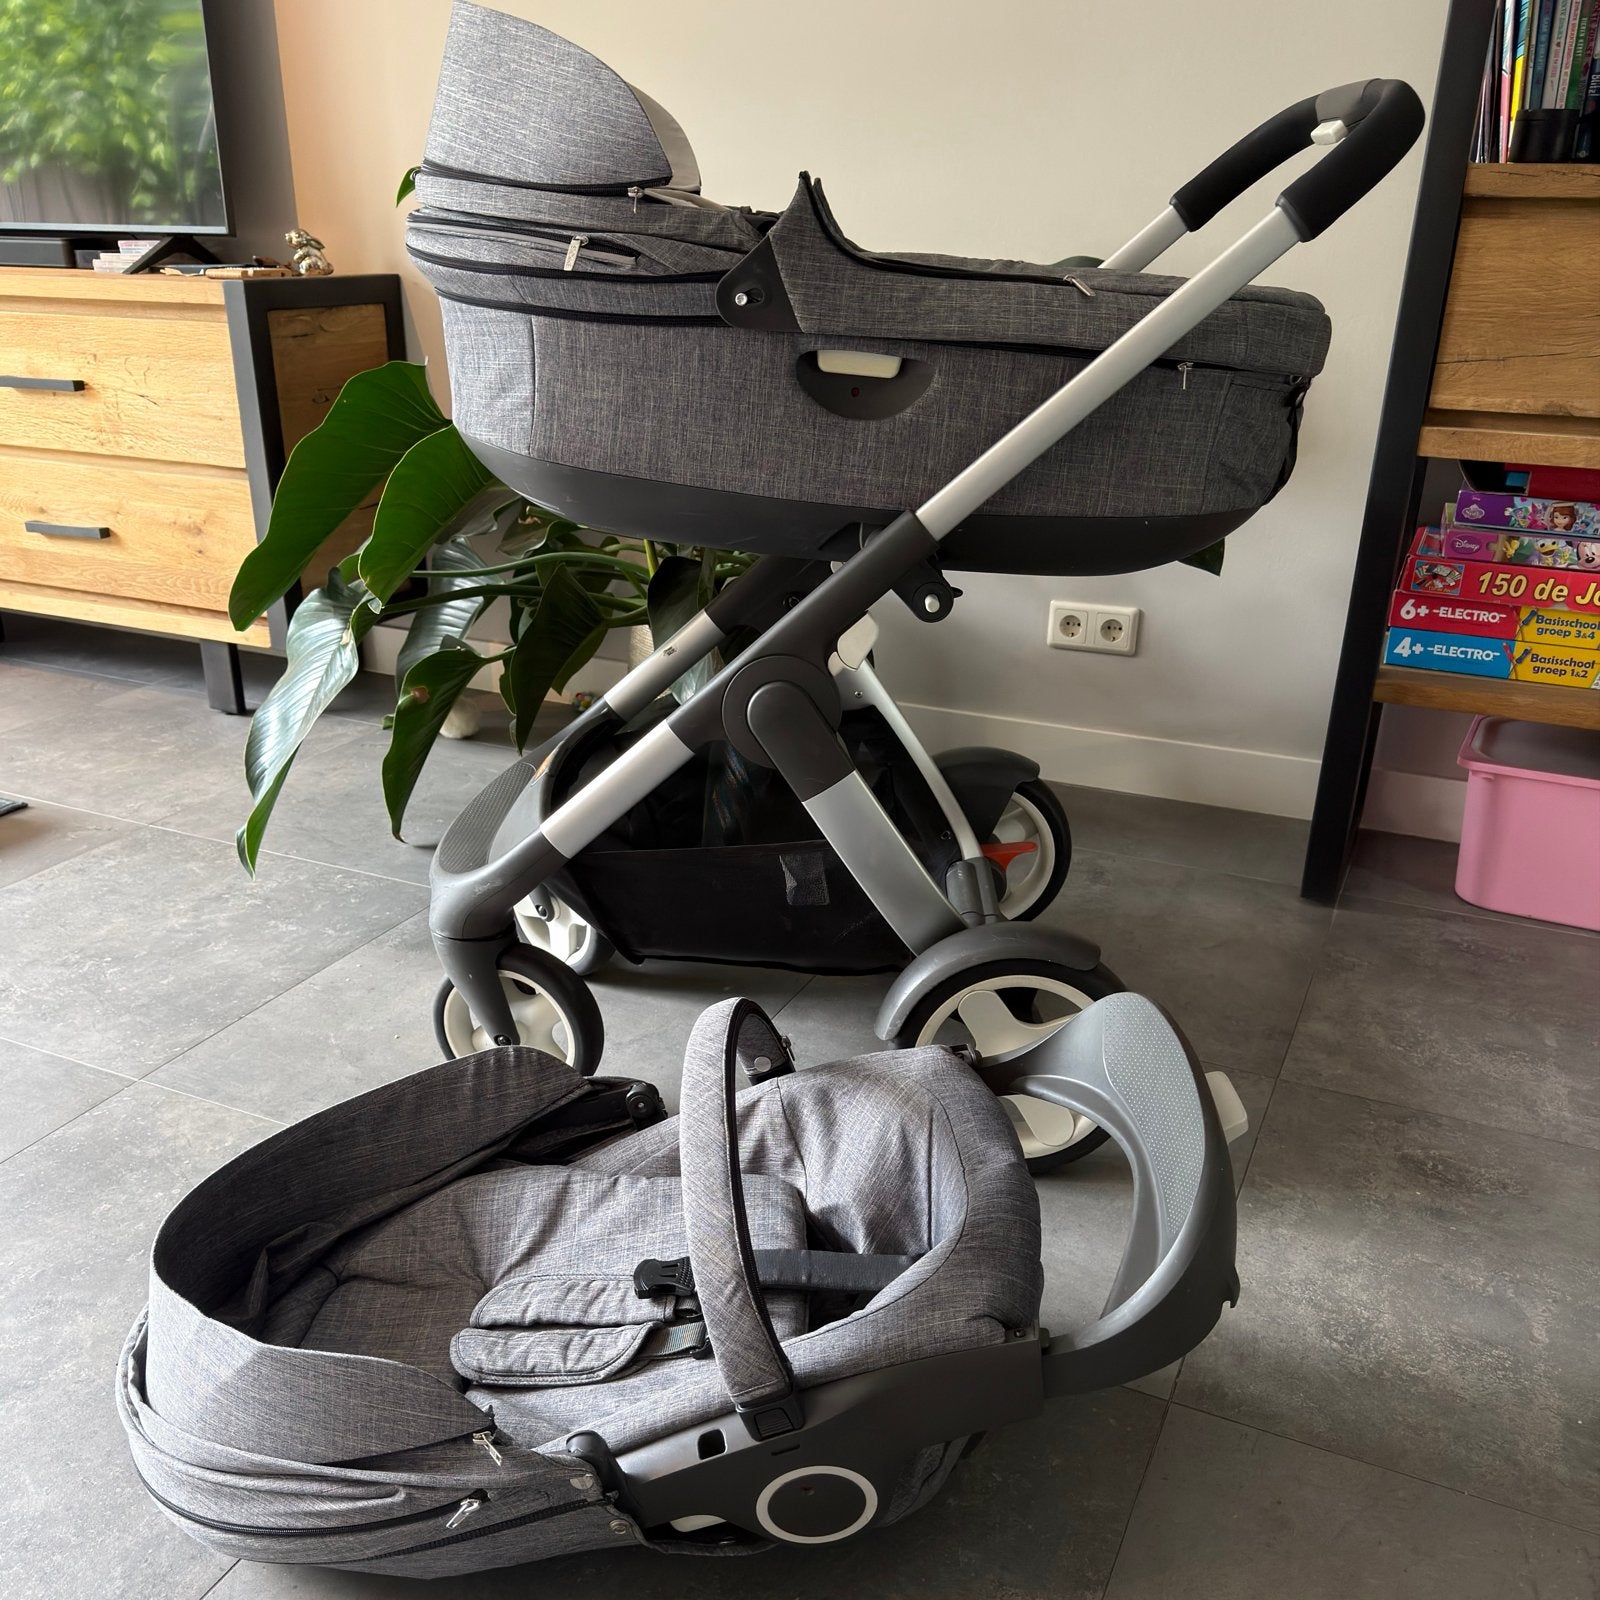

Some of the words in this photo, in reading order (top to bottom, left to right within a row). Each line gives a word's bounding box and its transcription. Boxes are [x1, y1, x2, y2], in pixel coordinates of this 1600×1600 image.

[1479, 571, 1527, 597] 150
[1533, 578, 1568, 602] de
[1400, 599, 1429, 620] 6+
[1536, 627, 1571, 638] groep
[1574, 630, 1595, 639] 3&4
[1393, 637, 1424, 657] 4+
[1530, 653, 1596, 669] Basisschool
[1532, 665, 1567, 677] groep
[1570, 669, 1588, 679] 1&2
